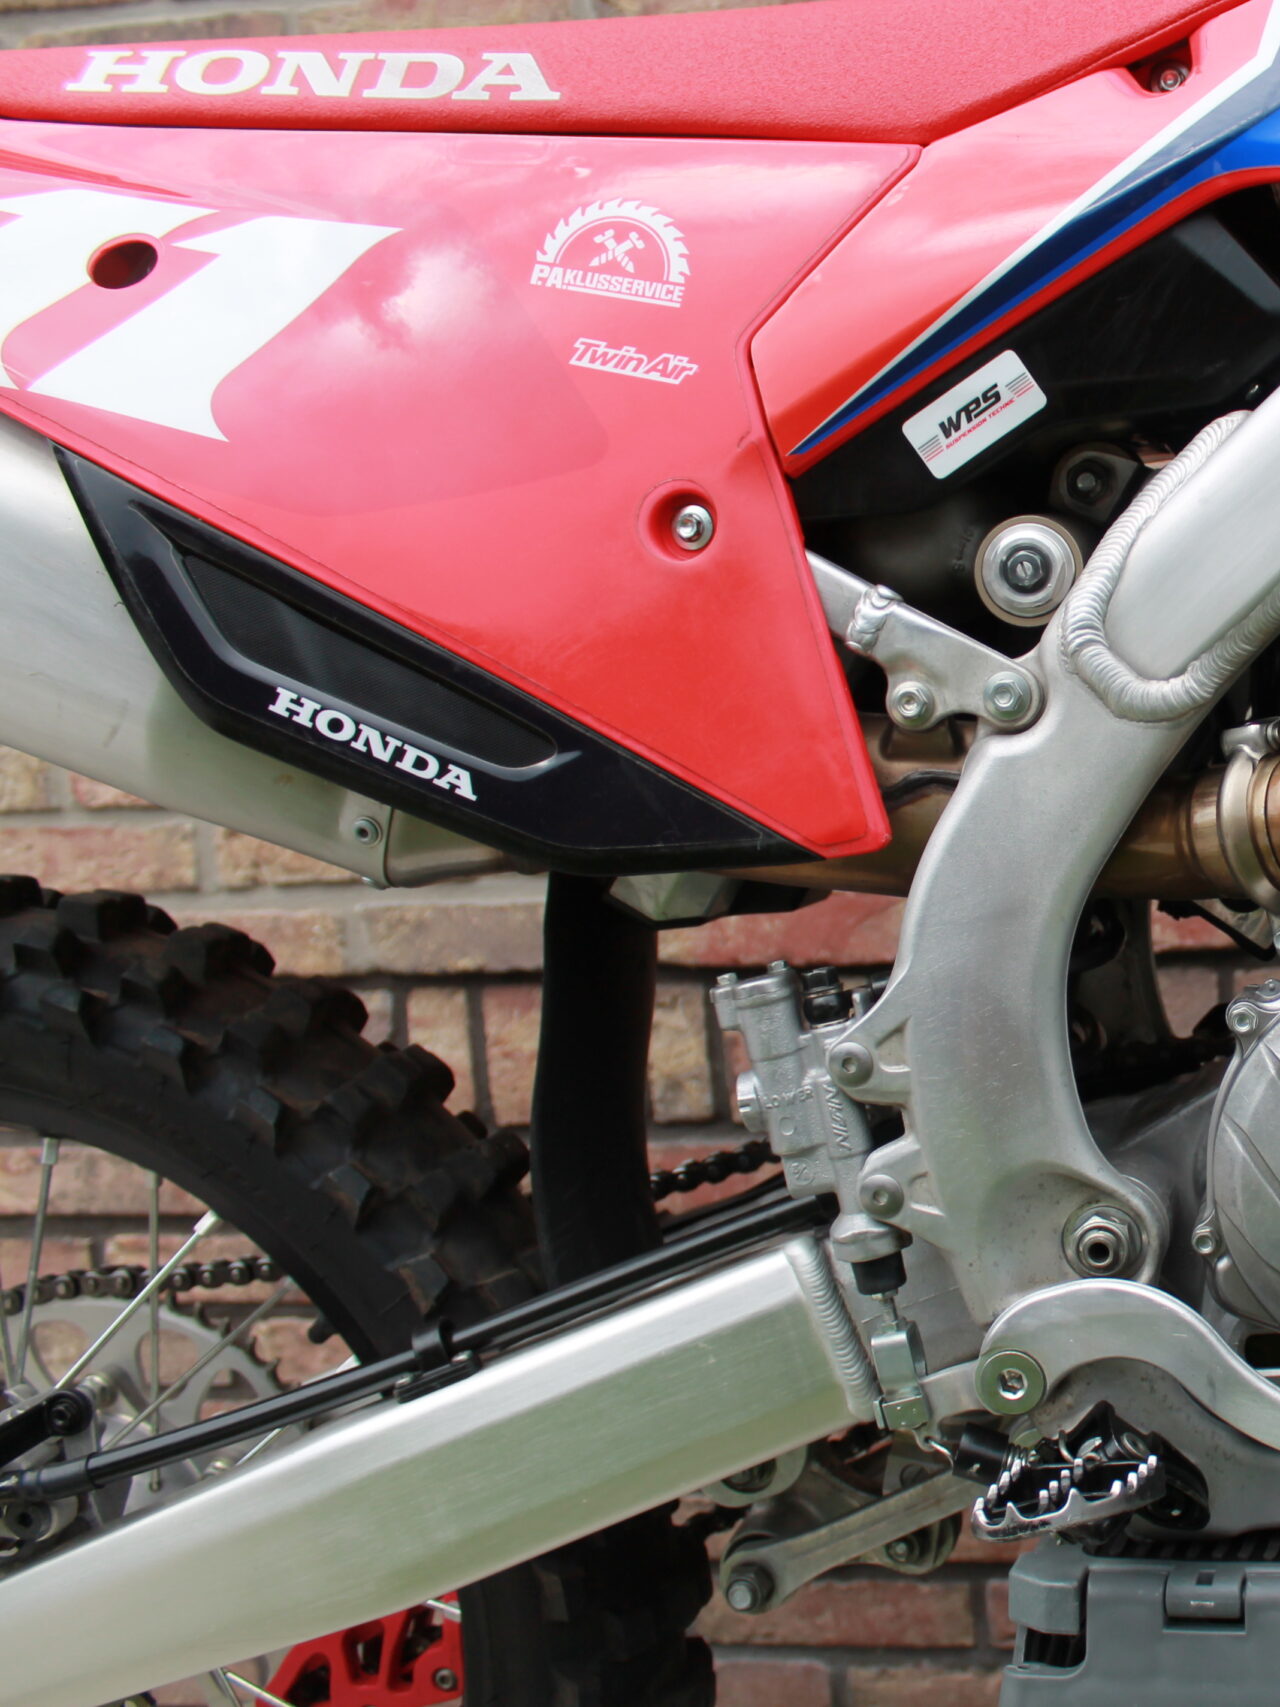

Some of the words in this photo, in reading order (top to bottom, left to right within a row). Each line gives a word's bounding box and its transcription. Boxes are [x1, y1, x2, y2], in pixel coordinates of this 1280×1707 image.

[65, 50, 561, 100] HONDA
[938, 382, 1001, 439] WPS
[268, 687, 478, 801] HONDA
